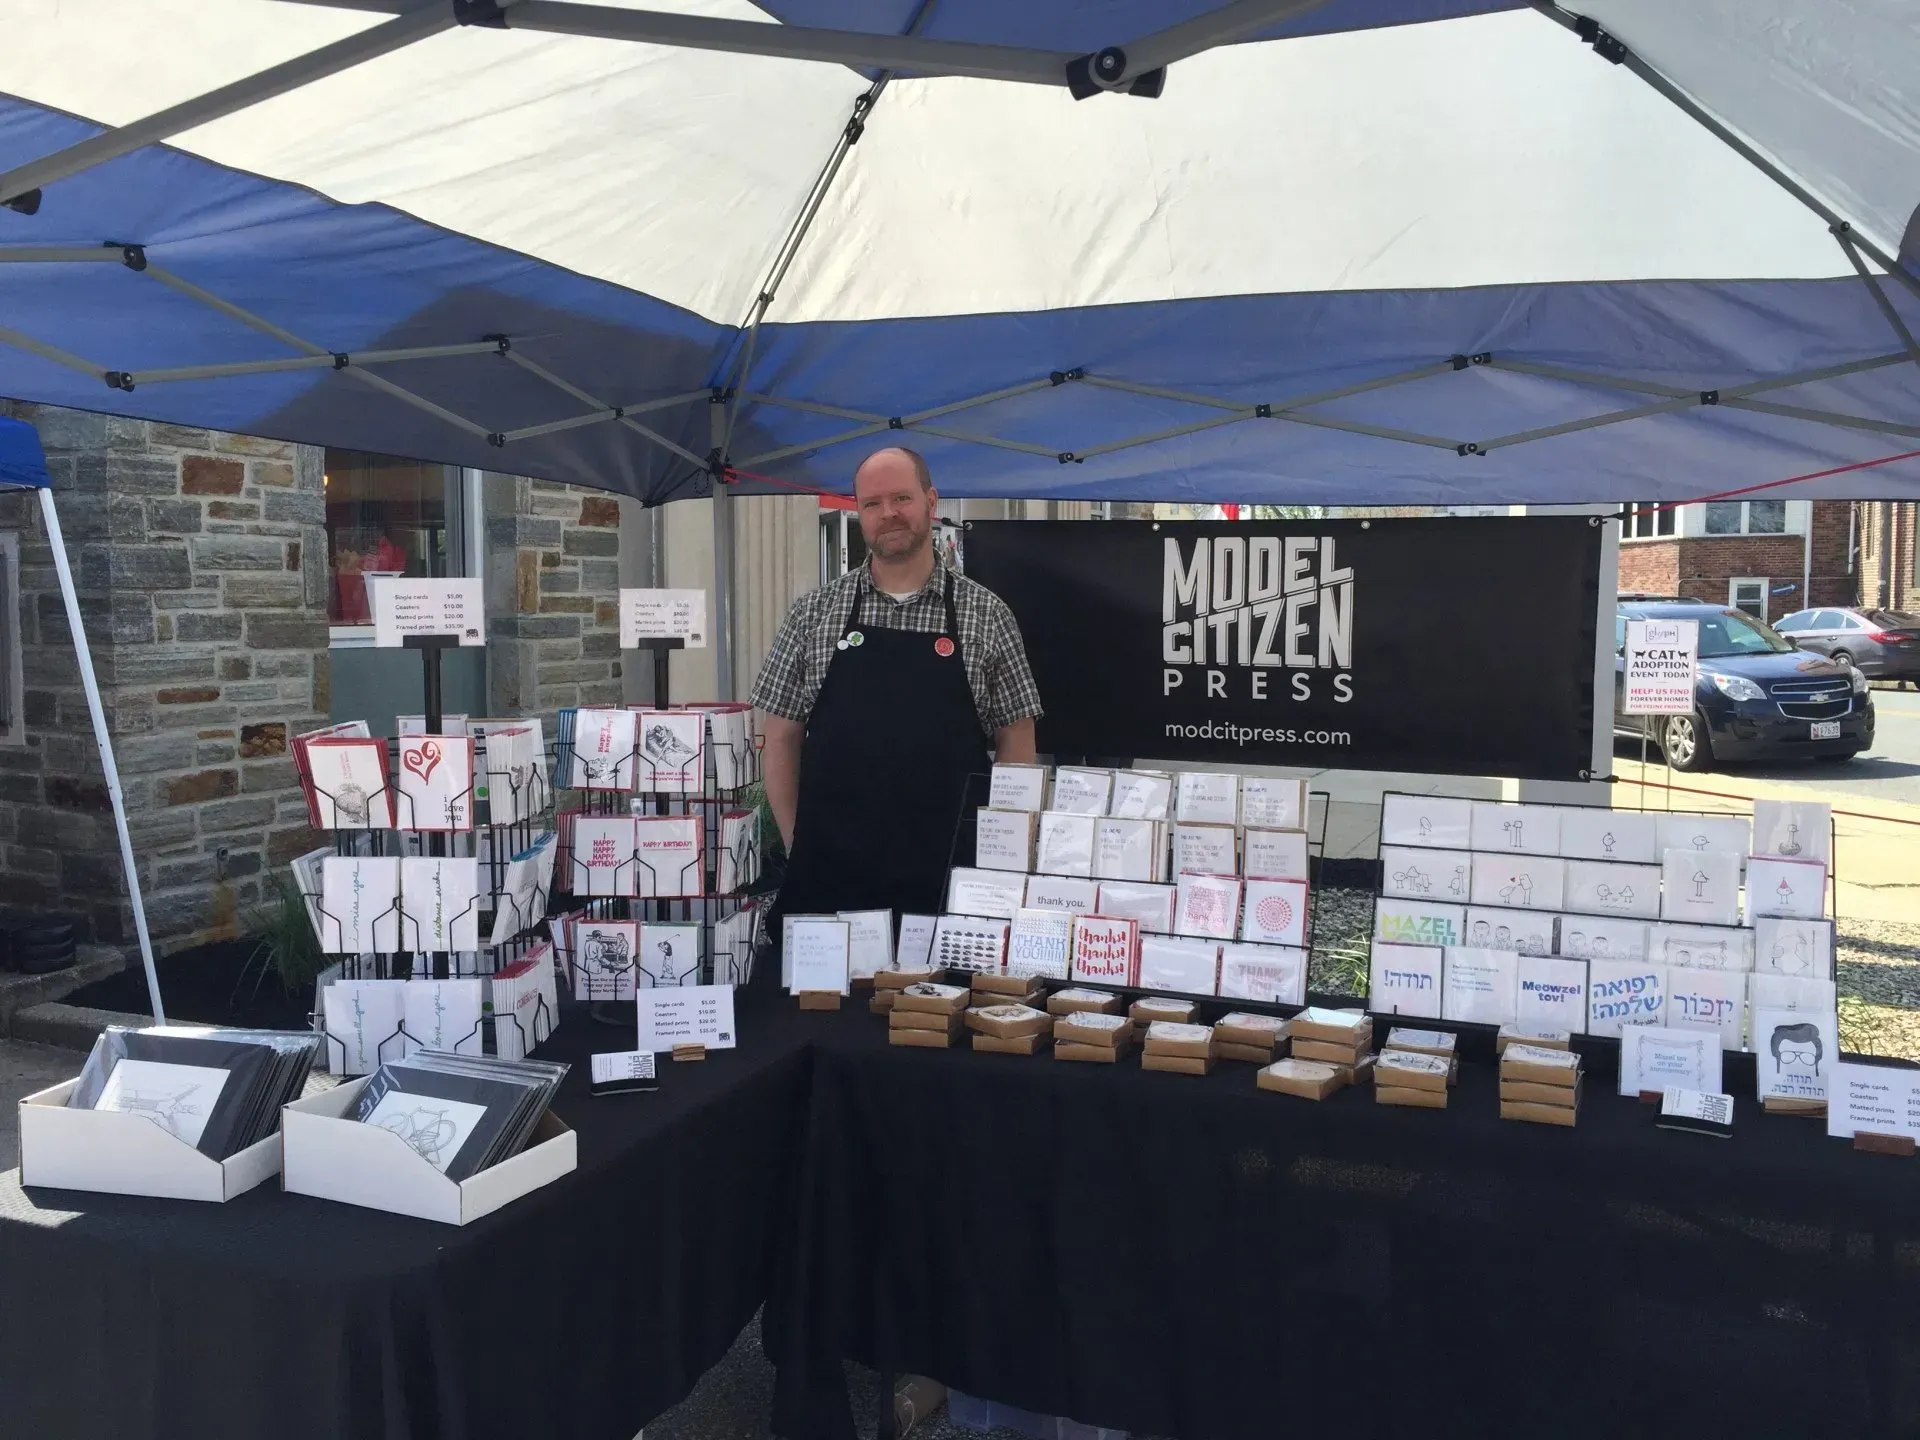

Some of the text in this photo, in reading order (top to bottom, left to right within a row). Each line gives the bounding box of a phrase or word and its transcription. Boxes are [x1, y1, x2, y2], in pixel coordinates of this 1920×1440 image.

[1162, 536, 1354, 625] MODEL
[1162, 581, 1354, 669] CITIZEN
[1648, 649, 1676, 660] CAT
[1632, 661, 1690, 669] ADOPTION
[1163, 668, 1354, 703] PRESS
[1165, 719, 1351, 747] modcitpress.com
[444, 803, 464, 812] love
[444, 814, 463, 823] you
[592, 846, 616, 854] HAPPY
[593, 839, 616, 847] HAPPY
[663, 840, 692, 848] BIRTHDAY!
[586, 859, 621, 868] BIRTHDAY!
[352, 870, 364, 896] you
[1037, 895, 1086, 909] thank you.
[350, 901, 359, 930] miss
[433, 902, 442, 939] distance
[1382, 911, 1457, 937] MAZEL
[1014, 934, 1066, 951] THANK
[1078, 925, 1126, 945] thanks!
[1077, 941, 1125, 961] thanks!
[1076, 956, 1124, 977] thanks!
[1384, 969, 1432, 990] תודה!
[1522, 980, 1581, 995] Meowzel
[1592, 975, 1659, 999] רפואה
[1538, 992, 1565, 1003] tov!
[1592, 995, 1663, 1020] שלמה!
[432, 993, 446, 1046] love you
[1798, 1086, 1825, 1096] תודה
[1849, 1081, 1870, 1090] Single
[1849, 1092, 1879, 1101] Coasters
[1849, 1103, 1875, 1112] Matted
[1849, 1114, 1875, 1122] Framed
[1876, 1118, 1896, 1126] prints
